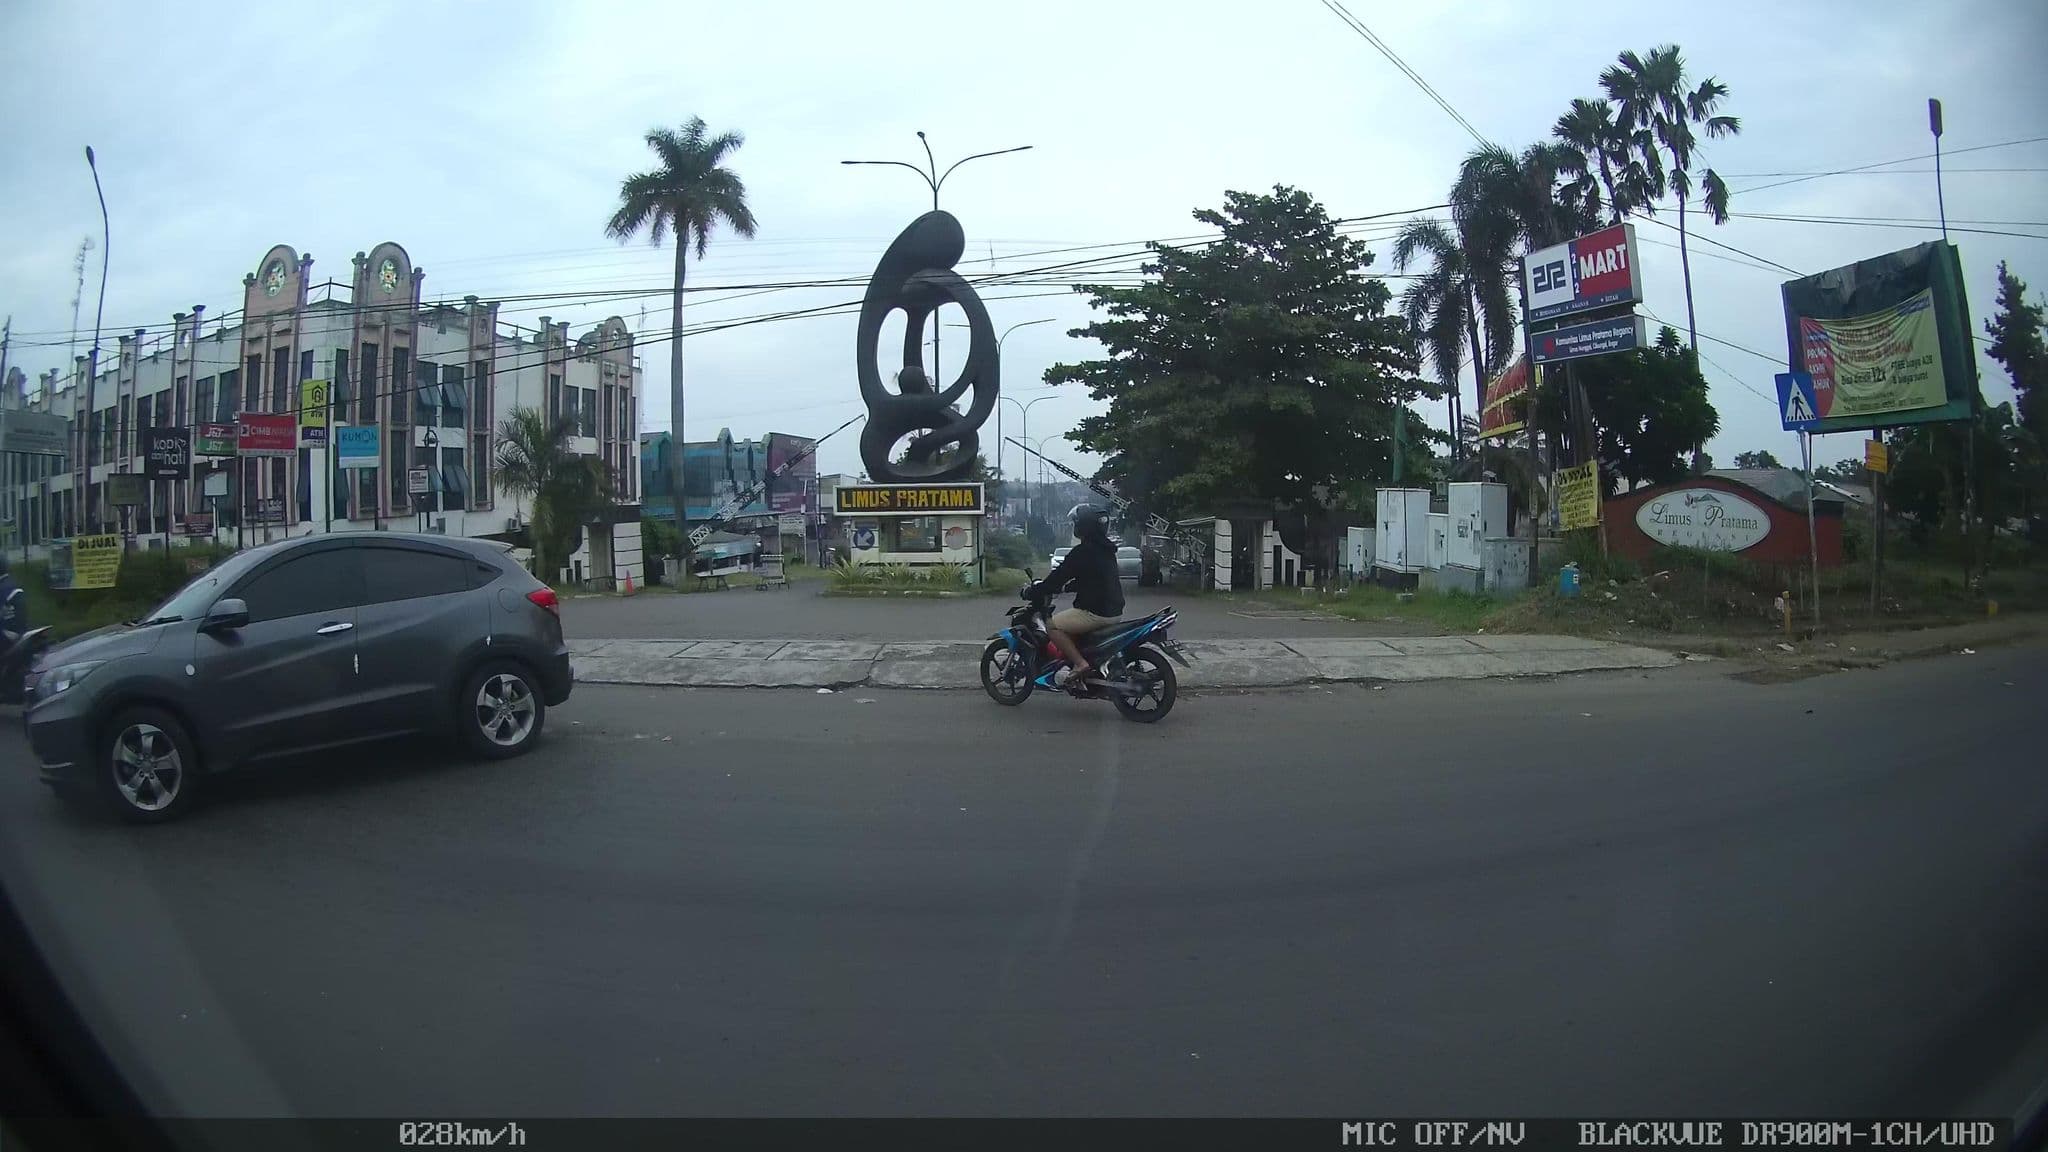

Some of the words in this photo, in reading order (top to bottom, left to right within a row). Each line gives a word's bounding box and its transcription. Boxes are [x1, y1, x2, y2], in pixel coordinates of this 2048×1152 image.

[1580, 243, 1627, 280] MART
[251, 426, 272, 436] CIMB
[342, 430, 377, 442] KUMON
[153, 437, 178, 451] kopi
[841, 489, 891, 508] LIMUS
[896, 488, 974, 508] PRATAMA
[1649, 502, 1692, 526] Limus
[1704, 504, 1759, 530] Pratama
